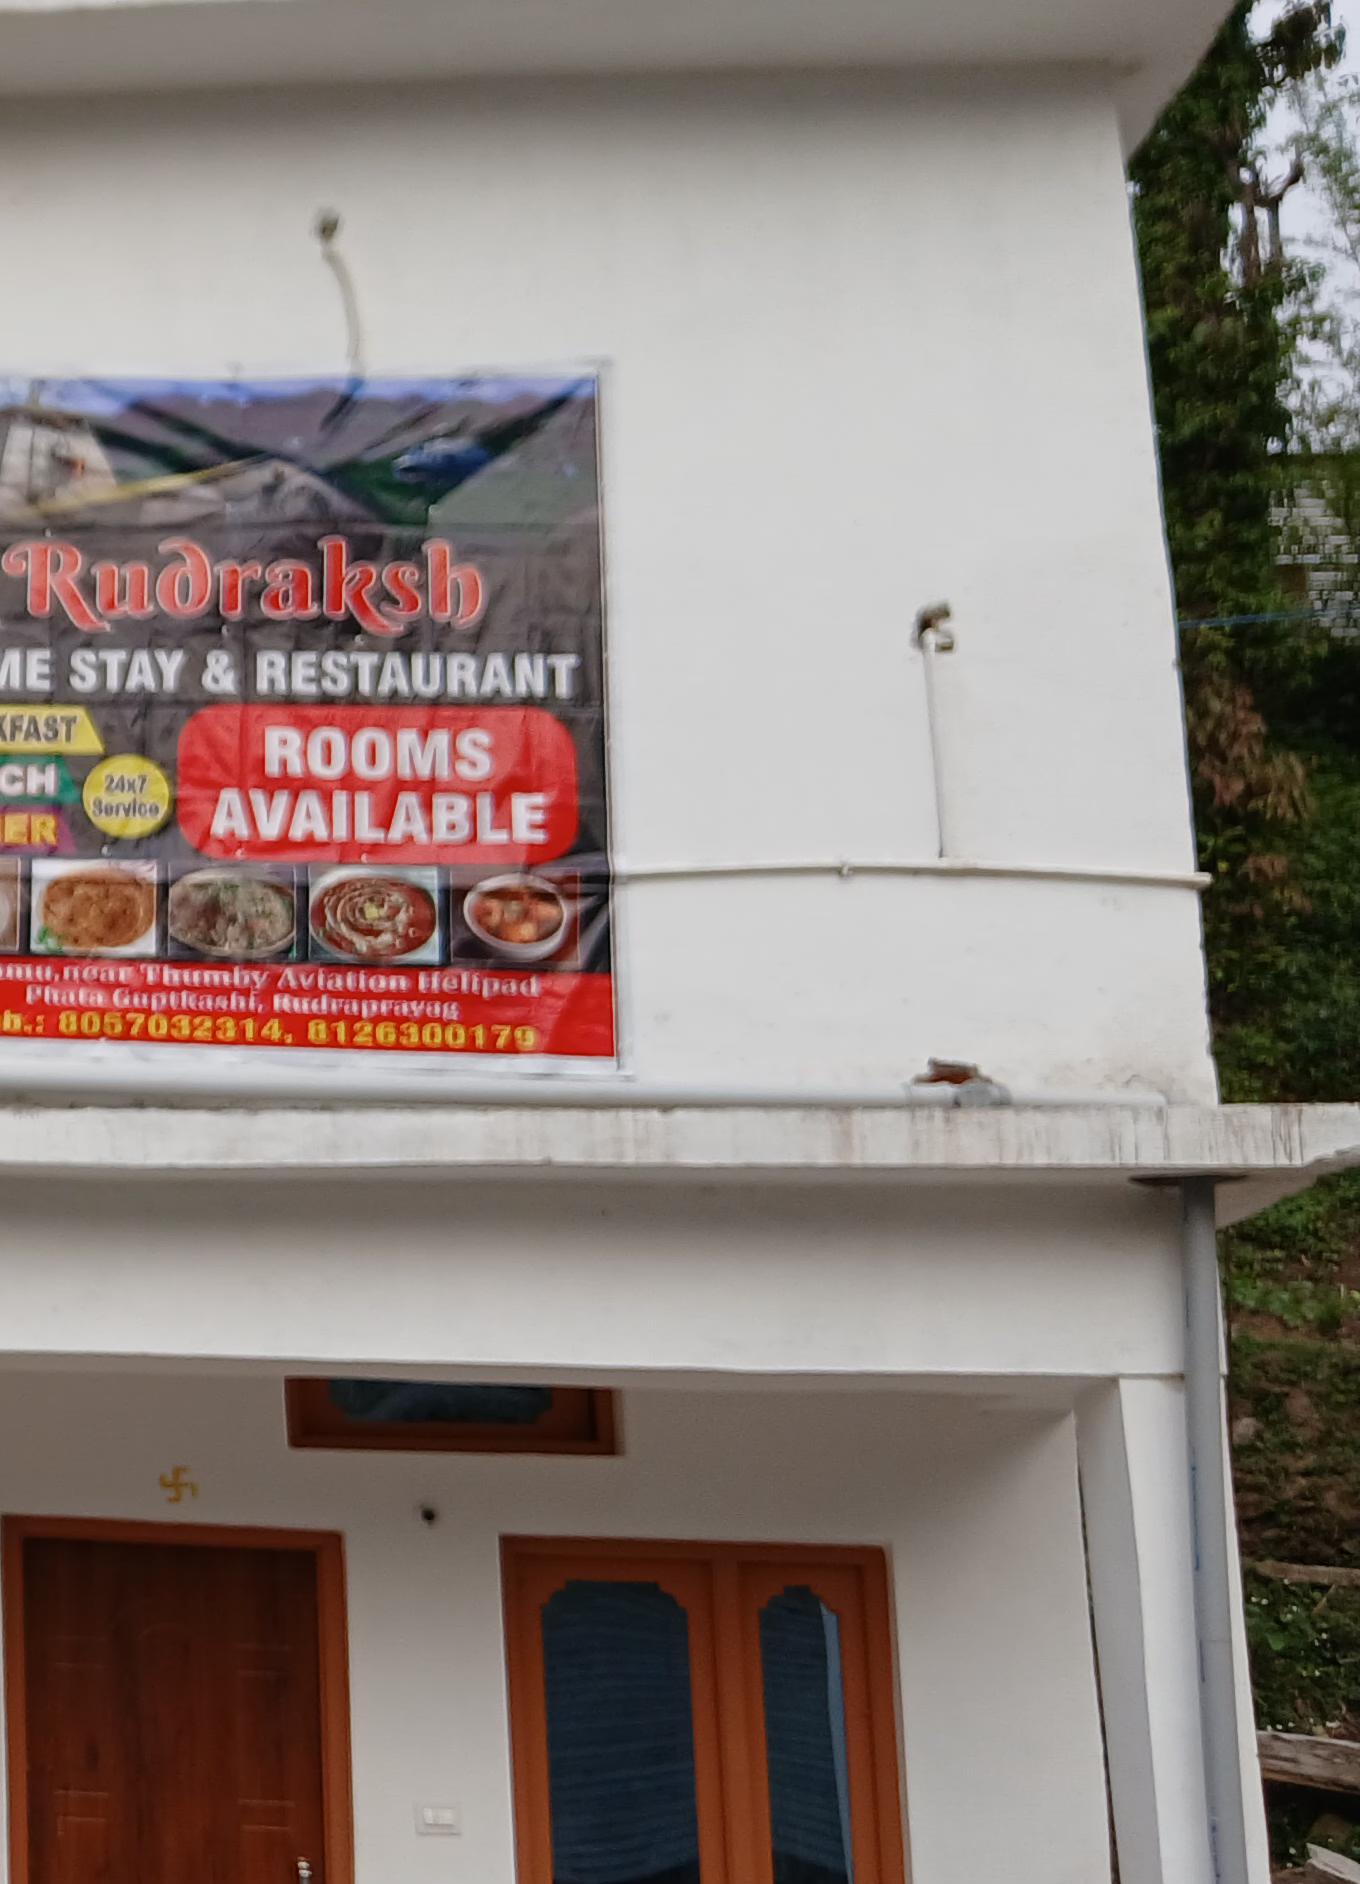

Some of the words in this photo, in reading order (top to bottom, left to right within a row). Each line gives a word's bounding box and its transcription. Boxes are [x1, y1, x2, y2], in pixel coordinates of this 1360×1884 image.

[0, 535, 484, 634] Rudraksh
[68, 650, 187, 694] STAY
[200, 651, 237, 695] &
[255, 652, 580, 700] RESTAURANT
[262, 725, 494, 780] ROOMS
[103, 773, 149, 796] 24x7
[92, 799, 161, 819] Service
[209, 789, 549, 845] AVAILABLE
[140, 963, 269, 990] Thumby
[277, 968, 410, 994] Aviation
[418, 971, 541, 998] Helipad
[25, 984, 105, 1006] Phata
[273, 993, 461, 1022] Rudraprayag
[307, 1017, 537, 1051] 8126300179
